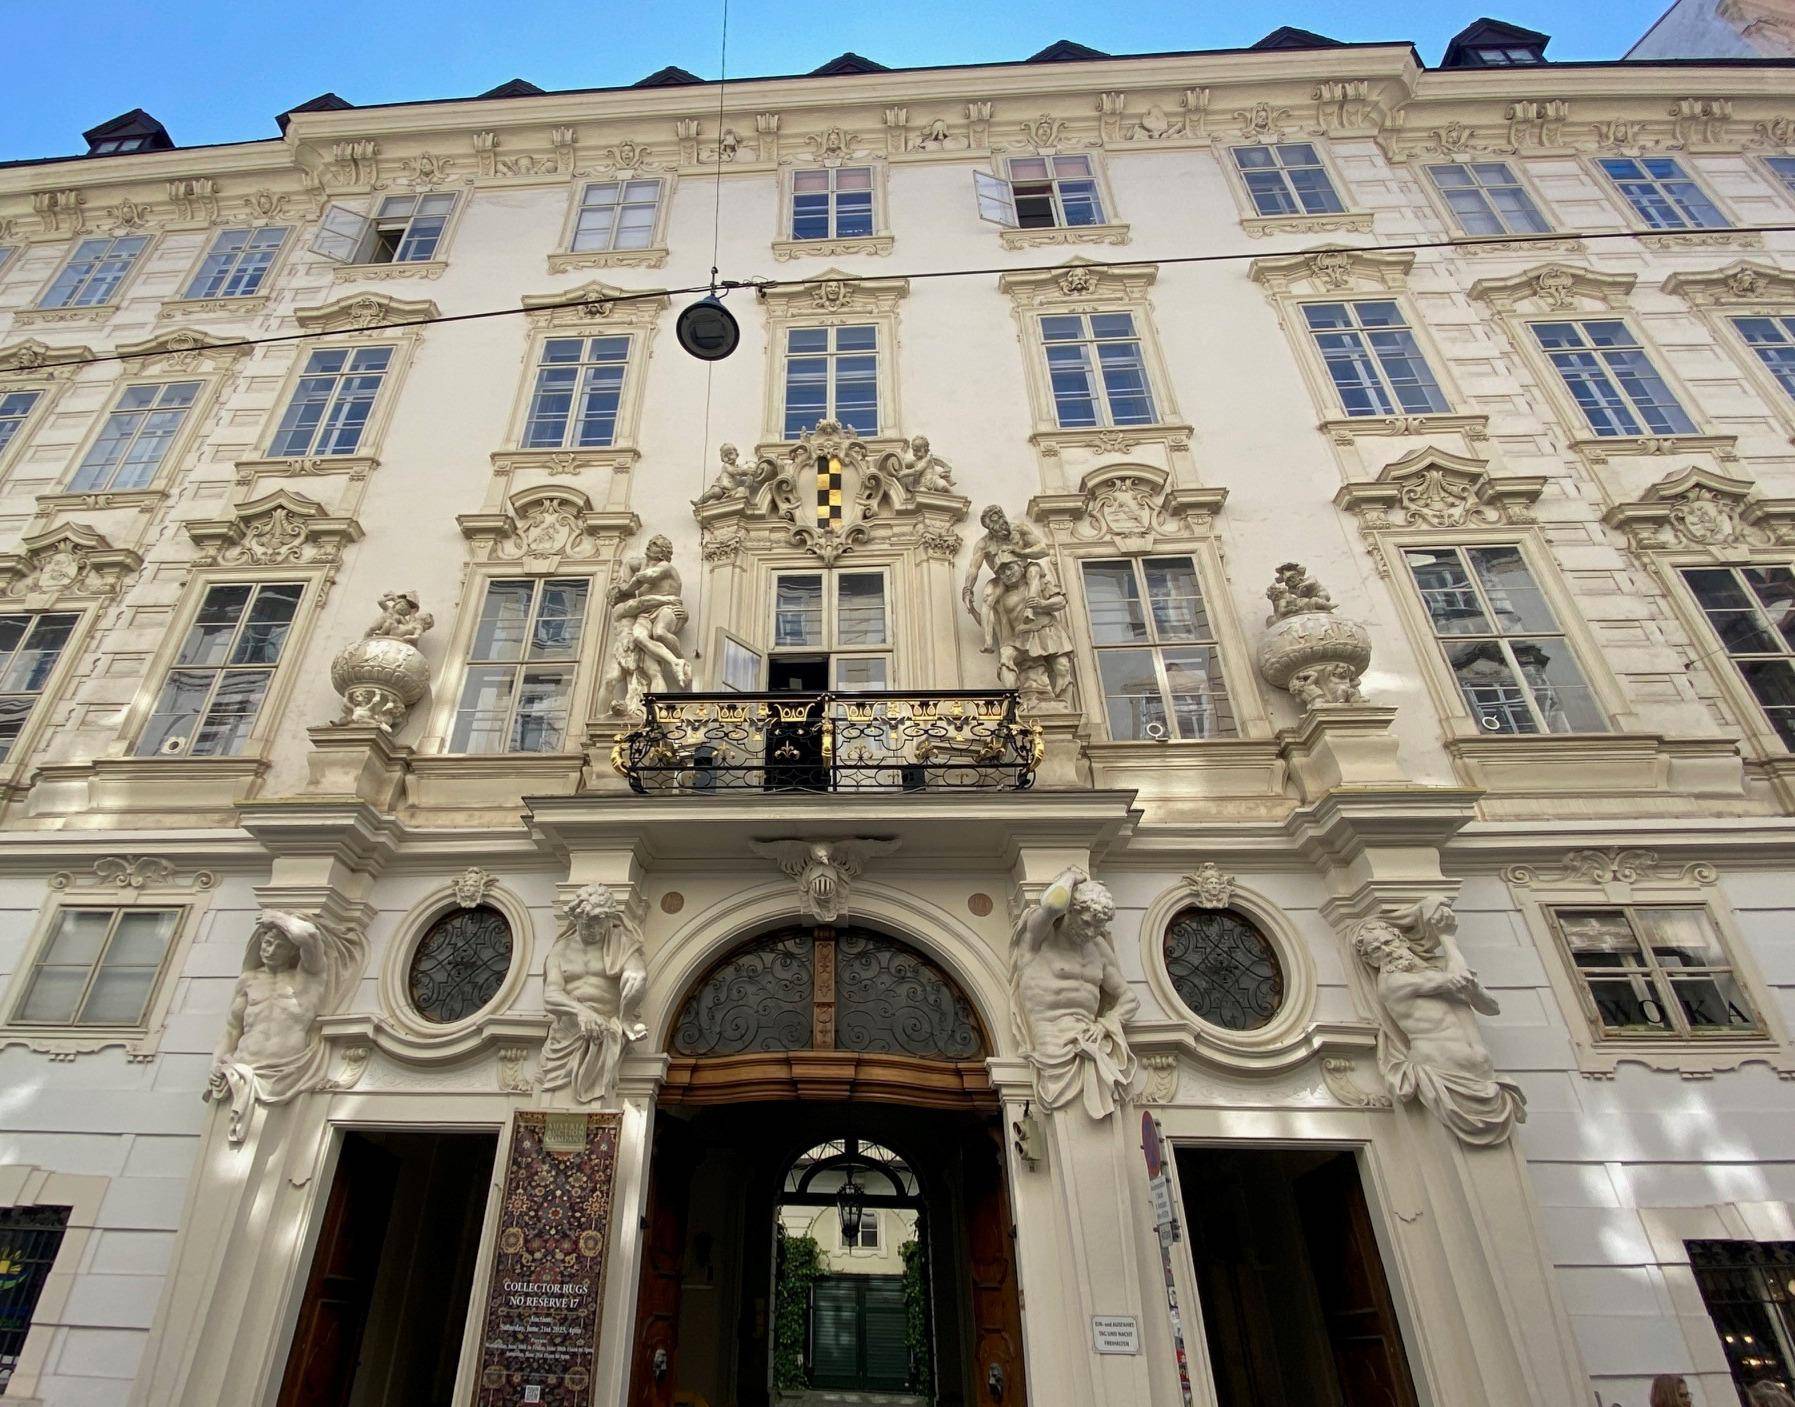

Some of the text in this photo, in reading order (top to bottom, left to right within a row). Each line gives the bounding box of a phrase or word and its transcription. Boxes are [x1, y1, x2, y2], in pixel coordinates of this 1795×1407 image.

[1599, 999, 1750, 1025] WOKA
[504, 1282, 588, 1294] COLLECTOR RUGS
[509, 1296, 579, 1308] NO RESERVE 17
